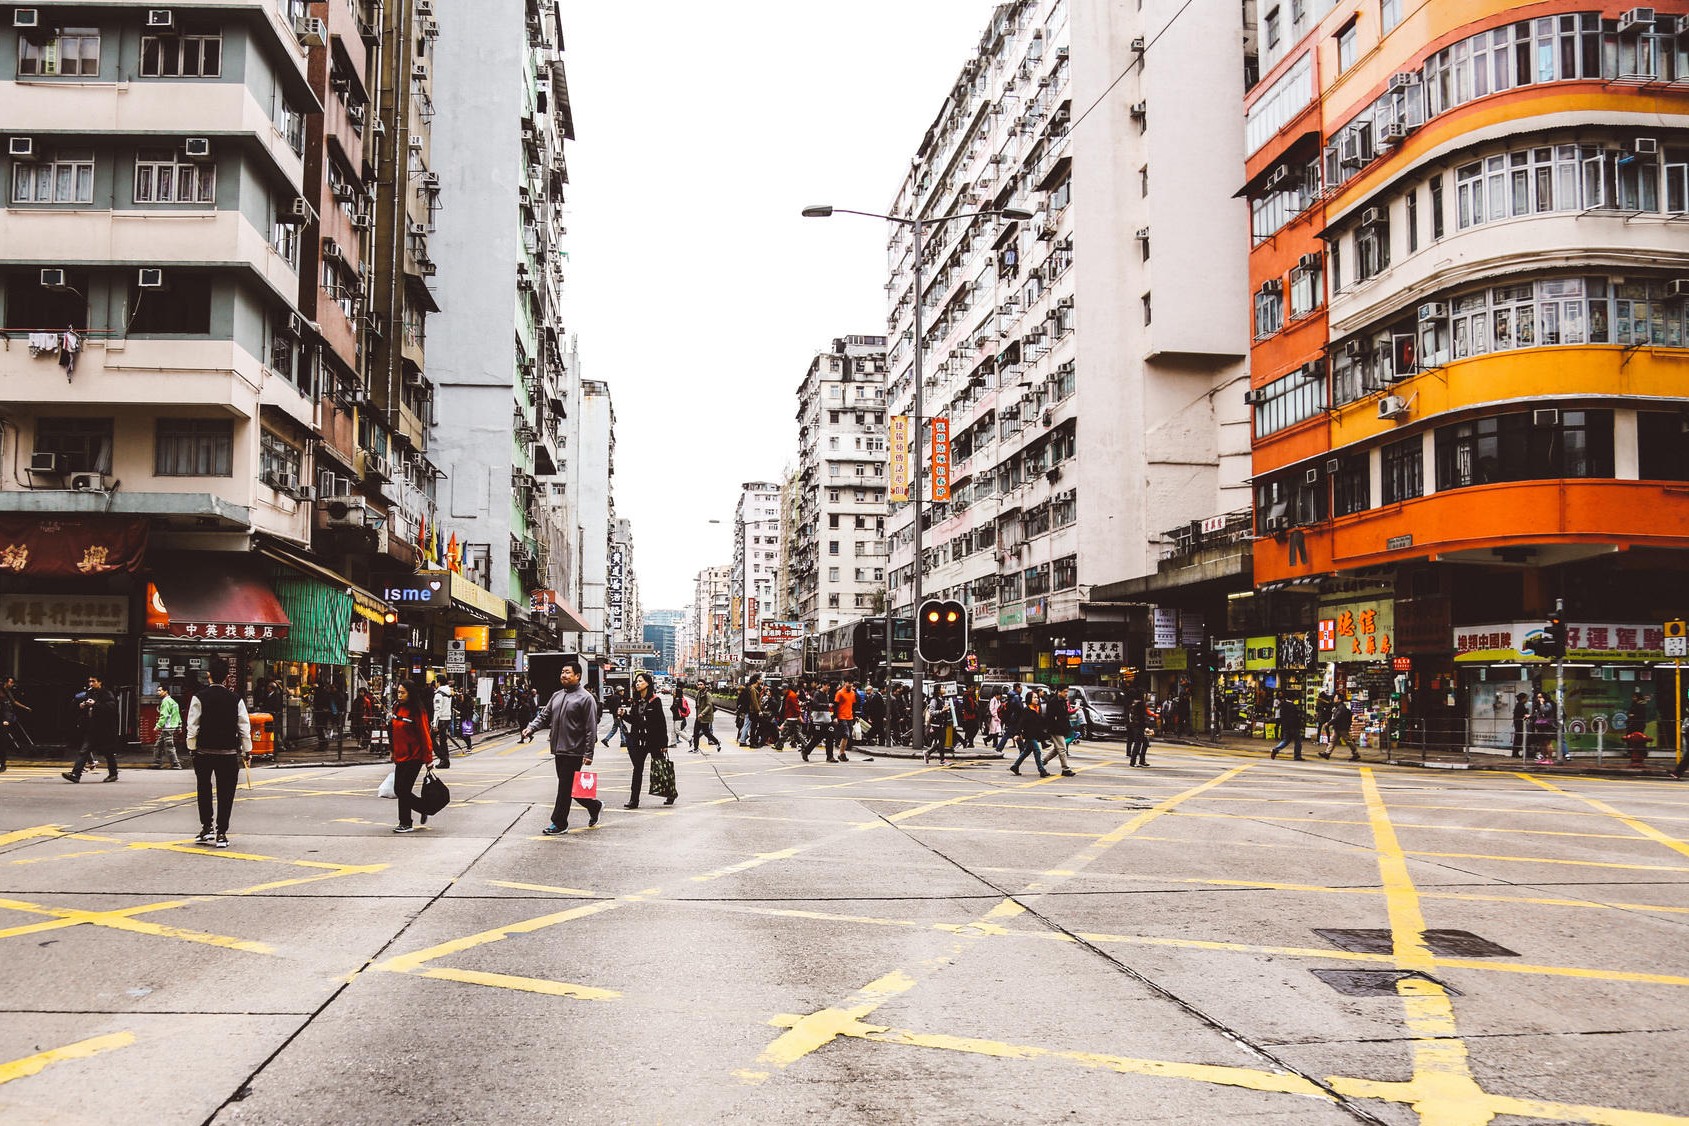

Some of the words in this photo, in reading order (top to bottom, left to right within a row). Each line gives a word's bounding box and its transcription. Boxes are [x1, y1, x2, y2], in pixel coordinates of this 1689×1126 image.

[384, 587, 432, 601] isme
[186, 623, 274, 638] 中英找換店
[1337, 610, 1377, 637] 德信
[1352, 633, 1391, 655] 大藥房
[1458, 632, 1511, 650] 換領中國牌
[898, 651, 908, 661] 41
